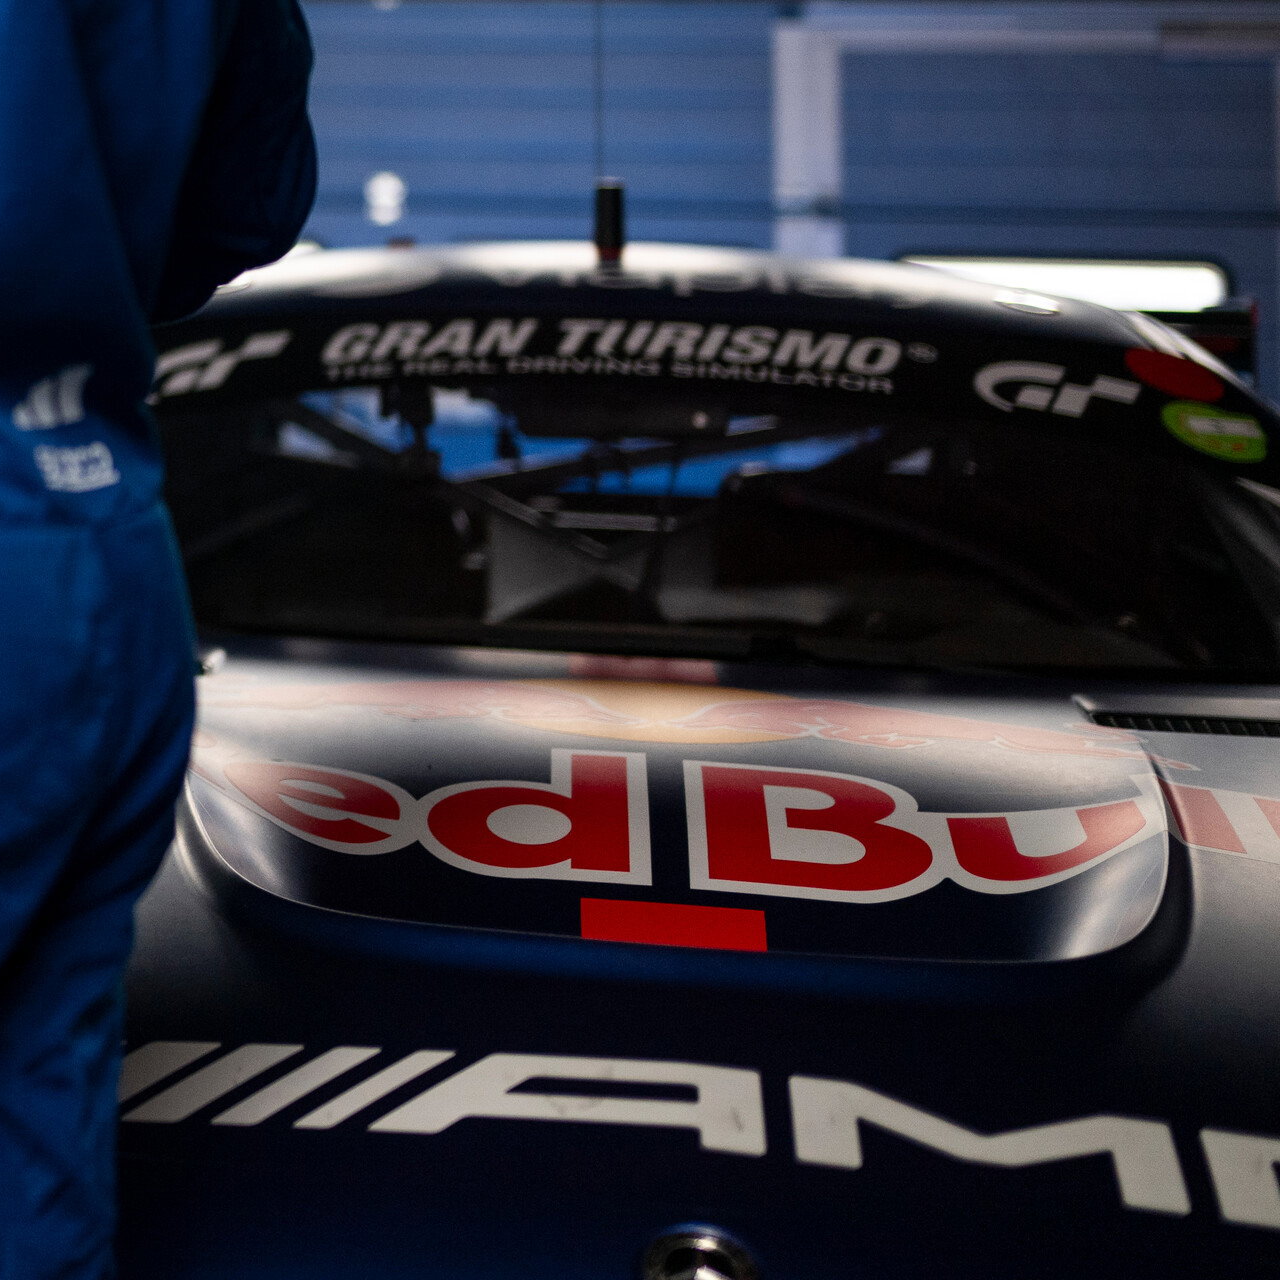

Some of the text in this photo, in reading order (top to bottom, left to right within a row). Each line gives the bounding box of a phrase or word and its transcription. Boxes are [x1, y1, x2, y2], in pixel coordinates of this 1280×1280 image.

[321, 317, 902, 376] GRAN TURISMO
[192, 745, 1280, 904] ed Bul
[366, 1053, 1280, 1229] AM
